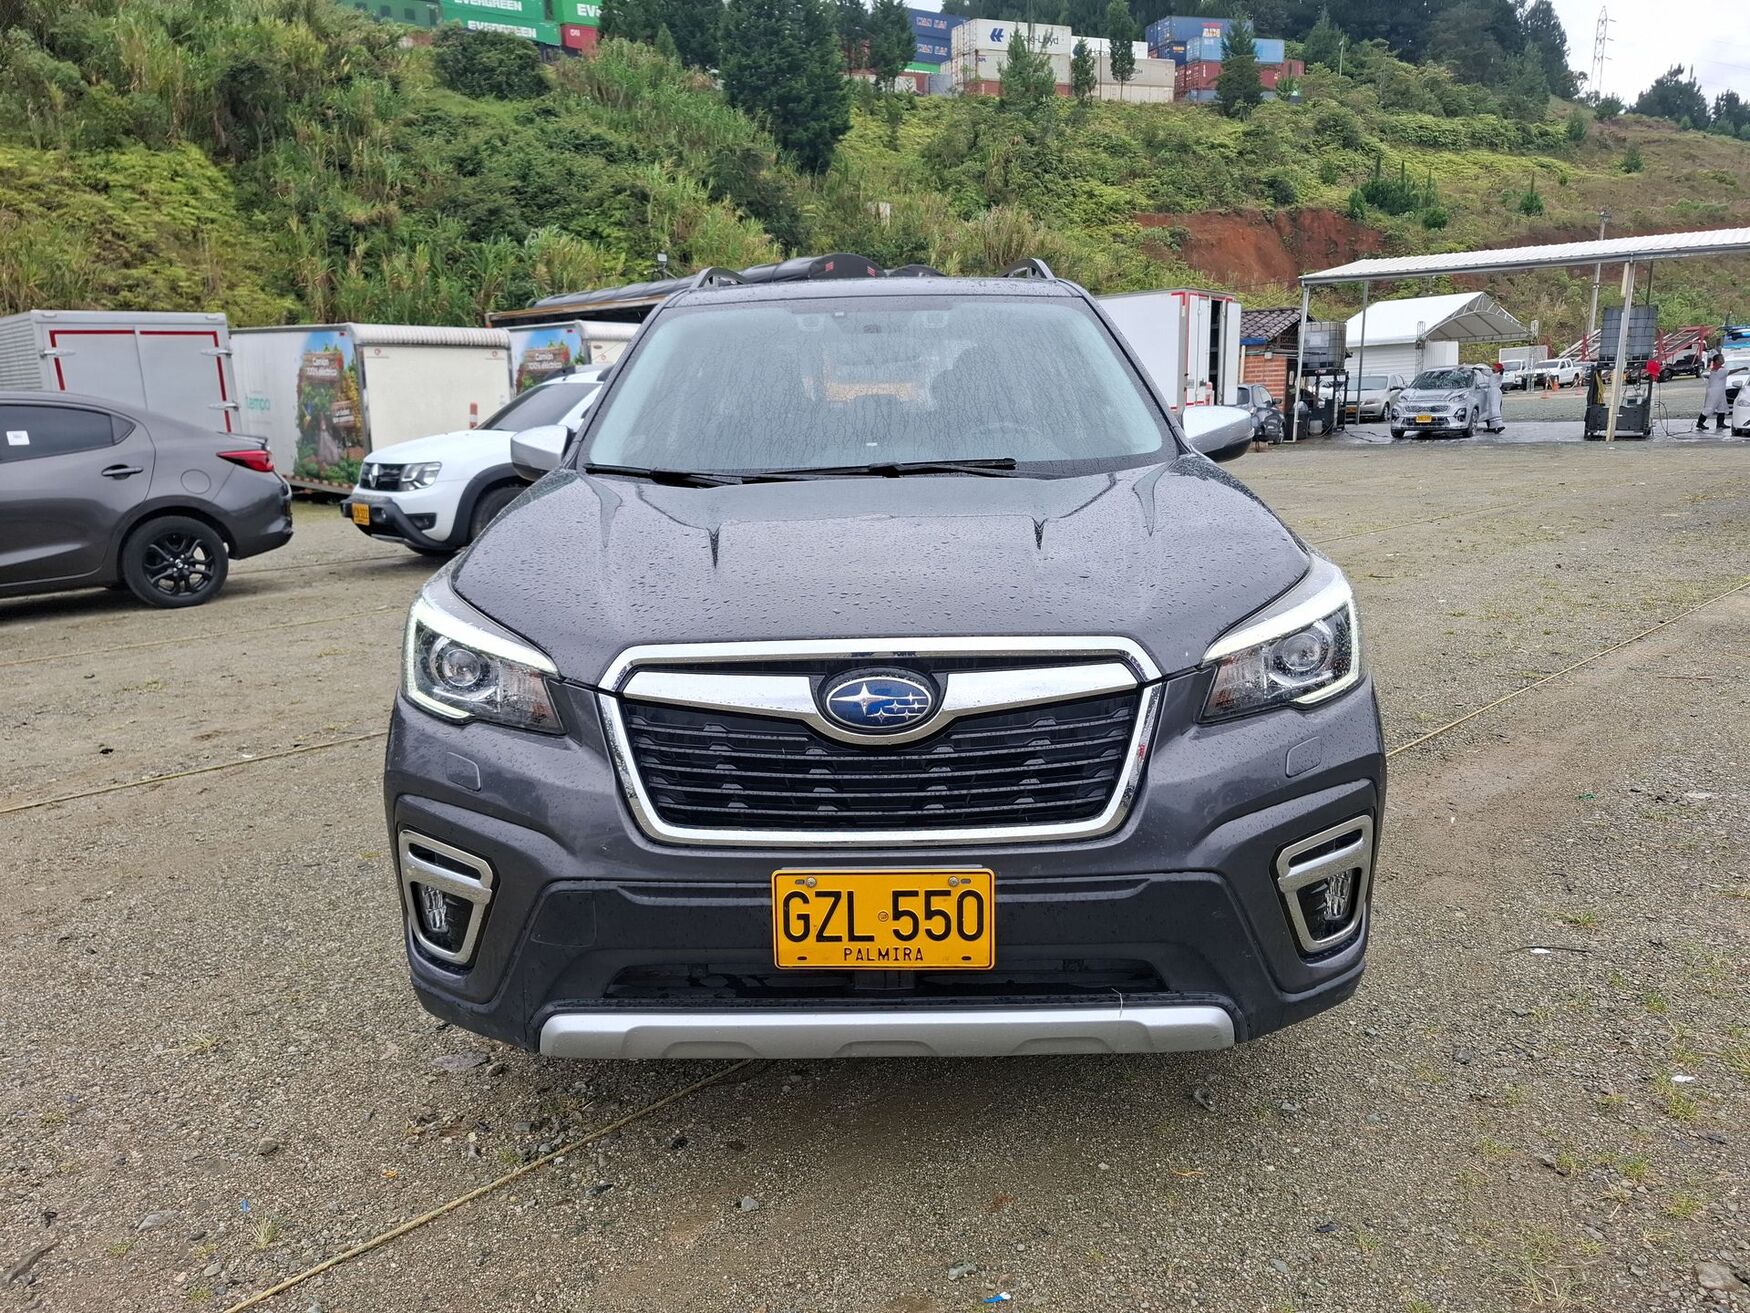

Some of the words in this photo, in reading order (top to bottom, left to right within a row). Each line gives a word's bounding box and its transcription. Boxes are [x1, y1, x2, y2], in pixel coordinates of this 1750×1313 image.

[454, 0, 523, 12] ERGREEN
[1009, 34, 1059, 47] Hpag-Lloyd
[782, 890, 875, 943] GZL
[891, 889, 984, 942] 550
[843, 947, 924, 962] PALMIRA
